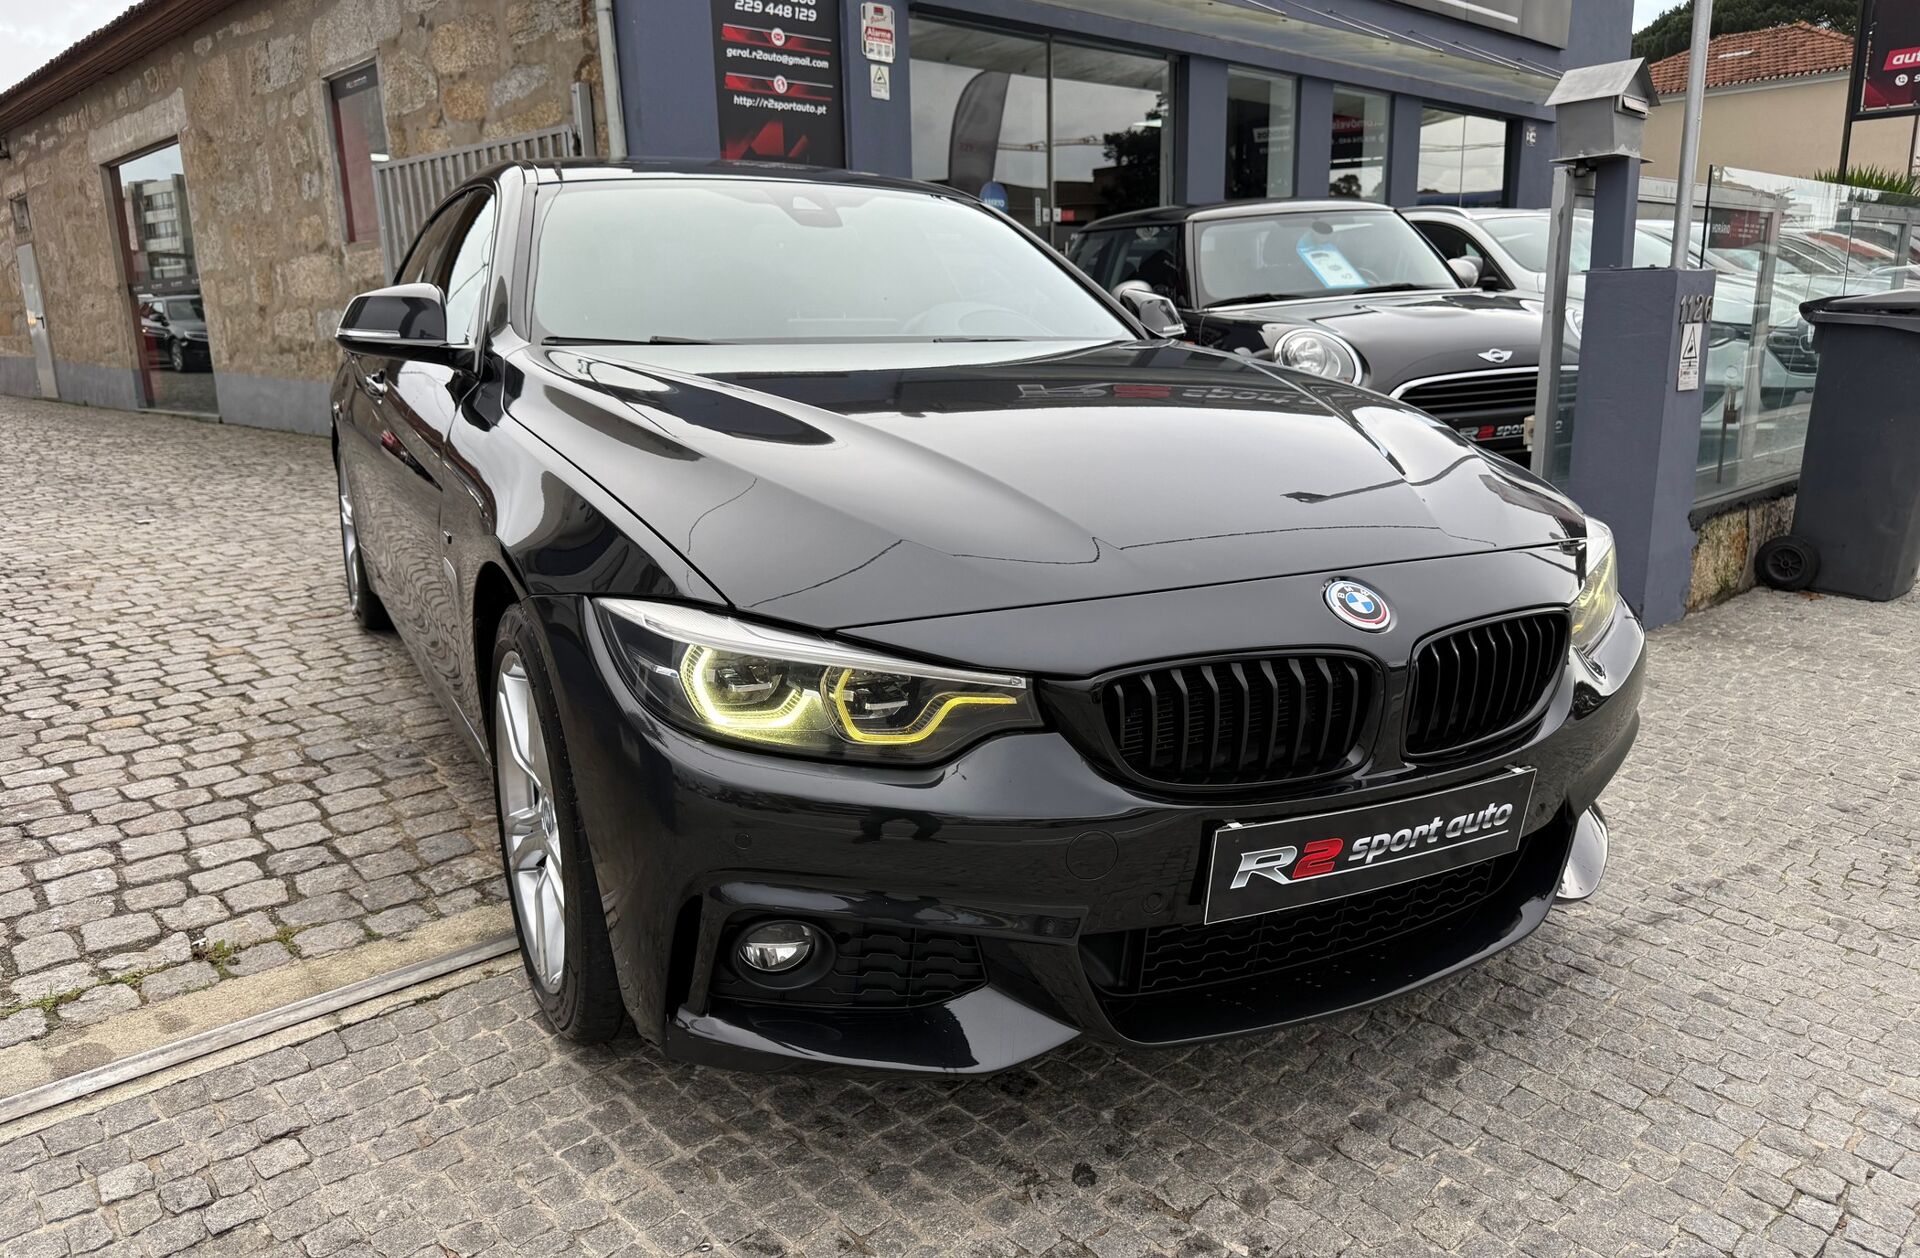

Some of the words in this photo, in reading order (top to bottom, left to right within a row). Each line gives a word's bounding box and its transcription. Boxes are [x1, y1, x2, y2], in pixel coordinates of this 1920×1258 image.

[735, 0, 763, 13] 229
[765, 3, 792, 18] 448
[795, 7, 817, 22] 129
[726, 47, 829, 69] geral.r2auto@gmail.com
[733, 95, 827, 115] http://r2sportauto.pt
[1680, 294, 1714, 322] 1126
[1496, 424, 1525, 436] spor
[1230, 837, 1344, 889] R2
[1348, 816, 1444, 864] sport
[1445, 802, 1513, 840] auto
